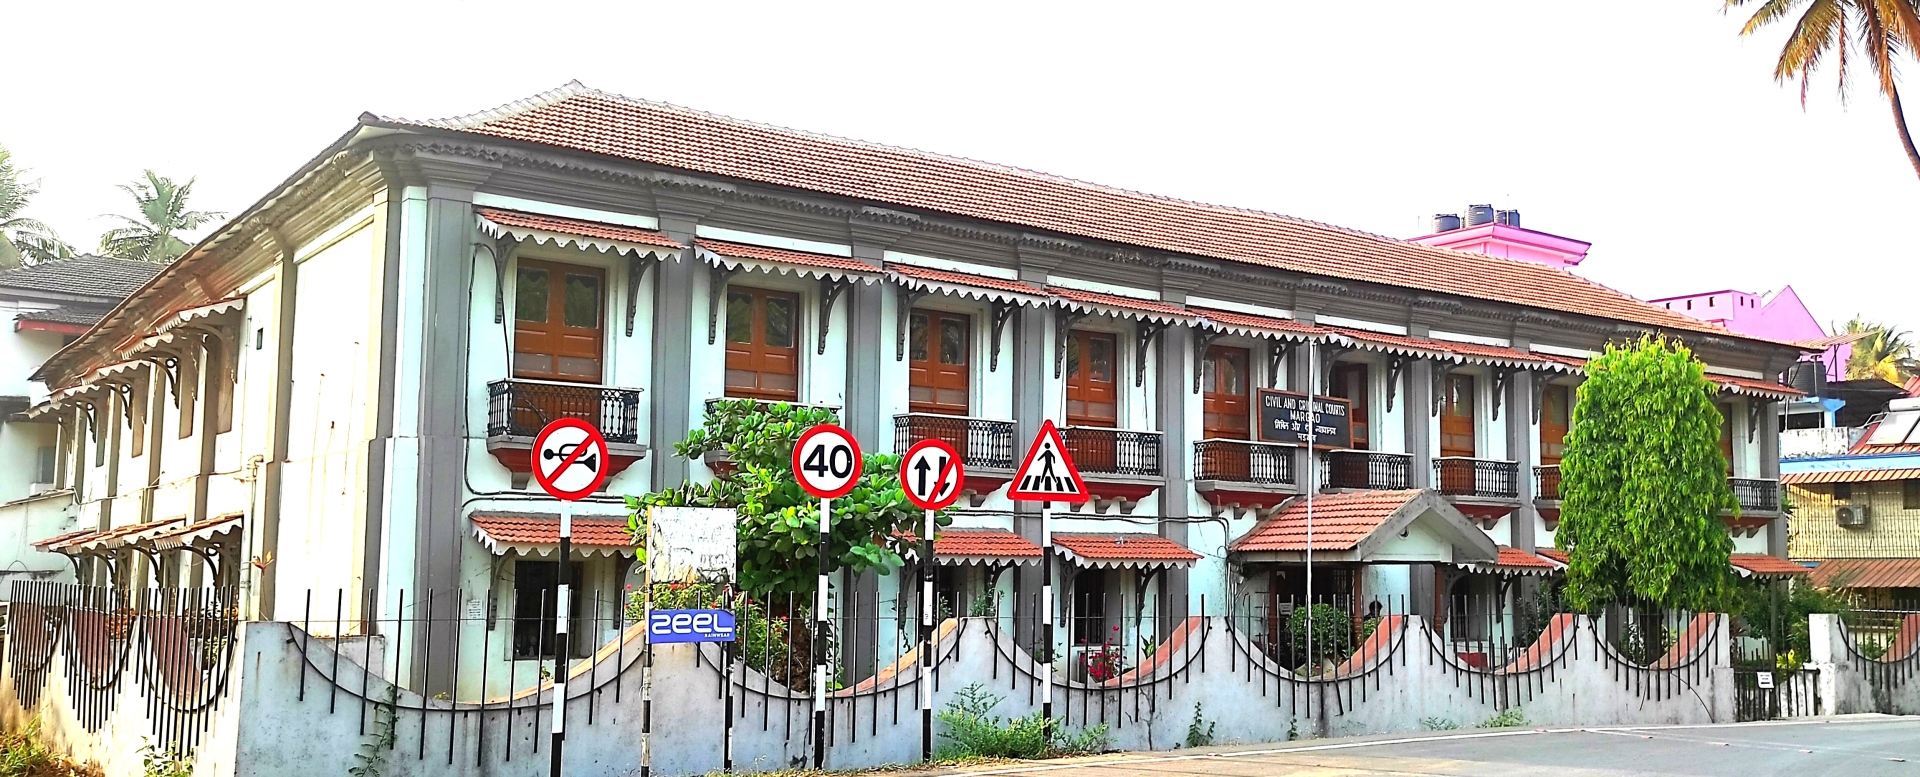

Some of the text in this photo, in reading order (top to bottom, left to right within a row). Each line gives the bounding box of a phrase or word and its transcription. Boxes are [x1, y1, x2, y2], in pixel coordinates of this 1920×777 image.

[1265, 395, 1345, 416] CIVIL AND CRINAL COURTS
[1290, 410, 1321, 423] MARGAO
[803, 444, 853, 479] 40
